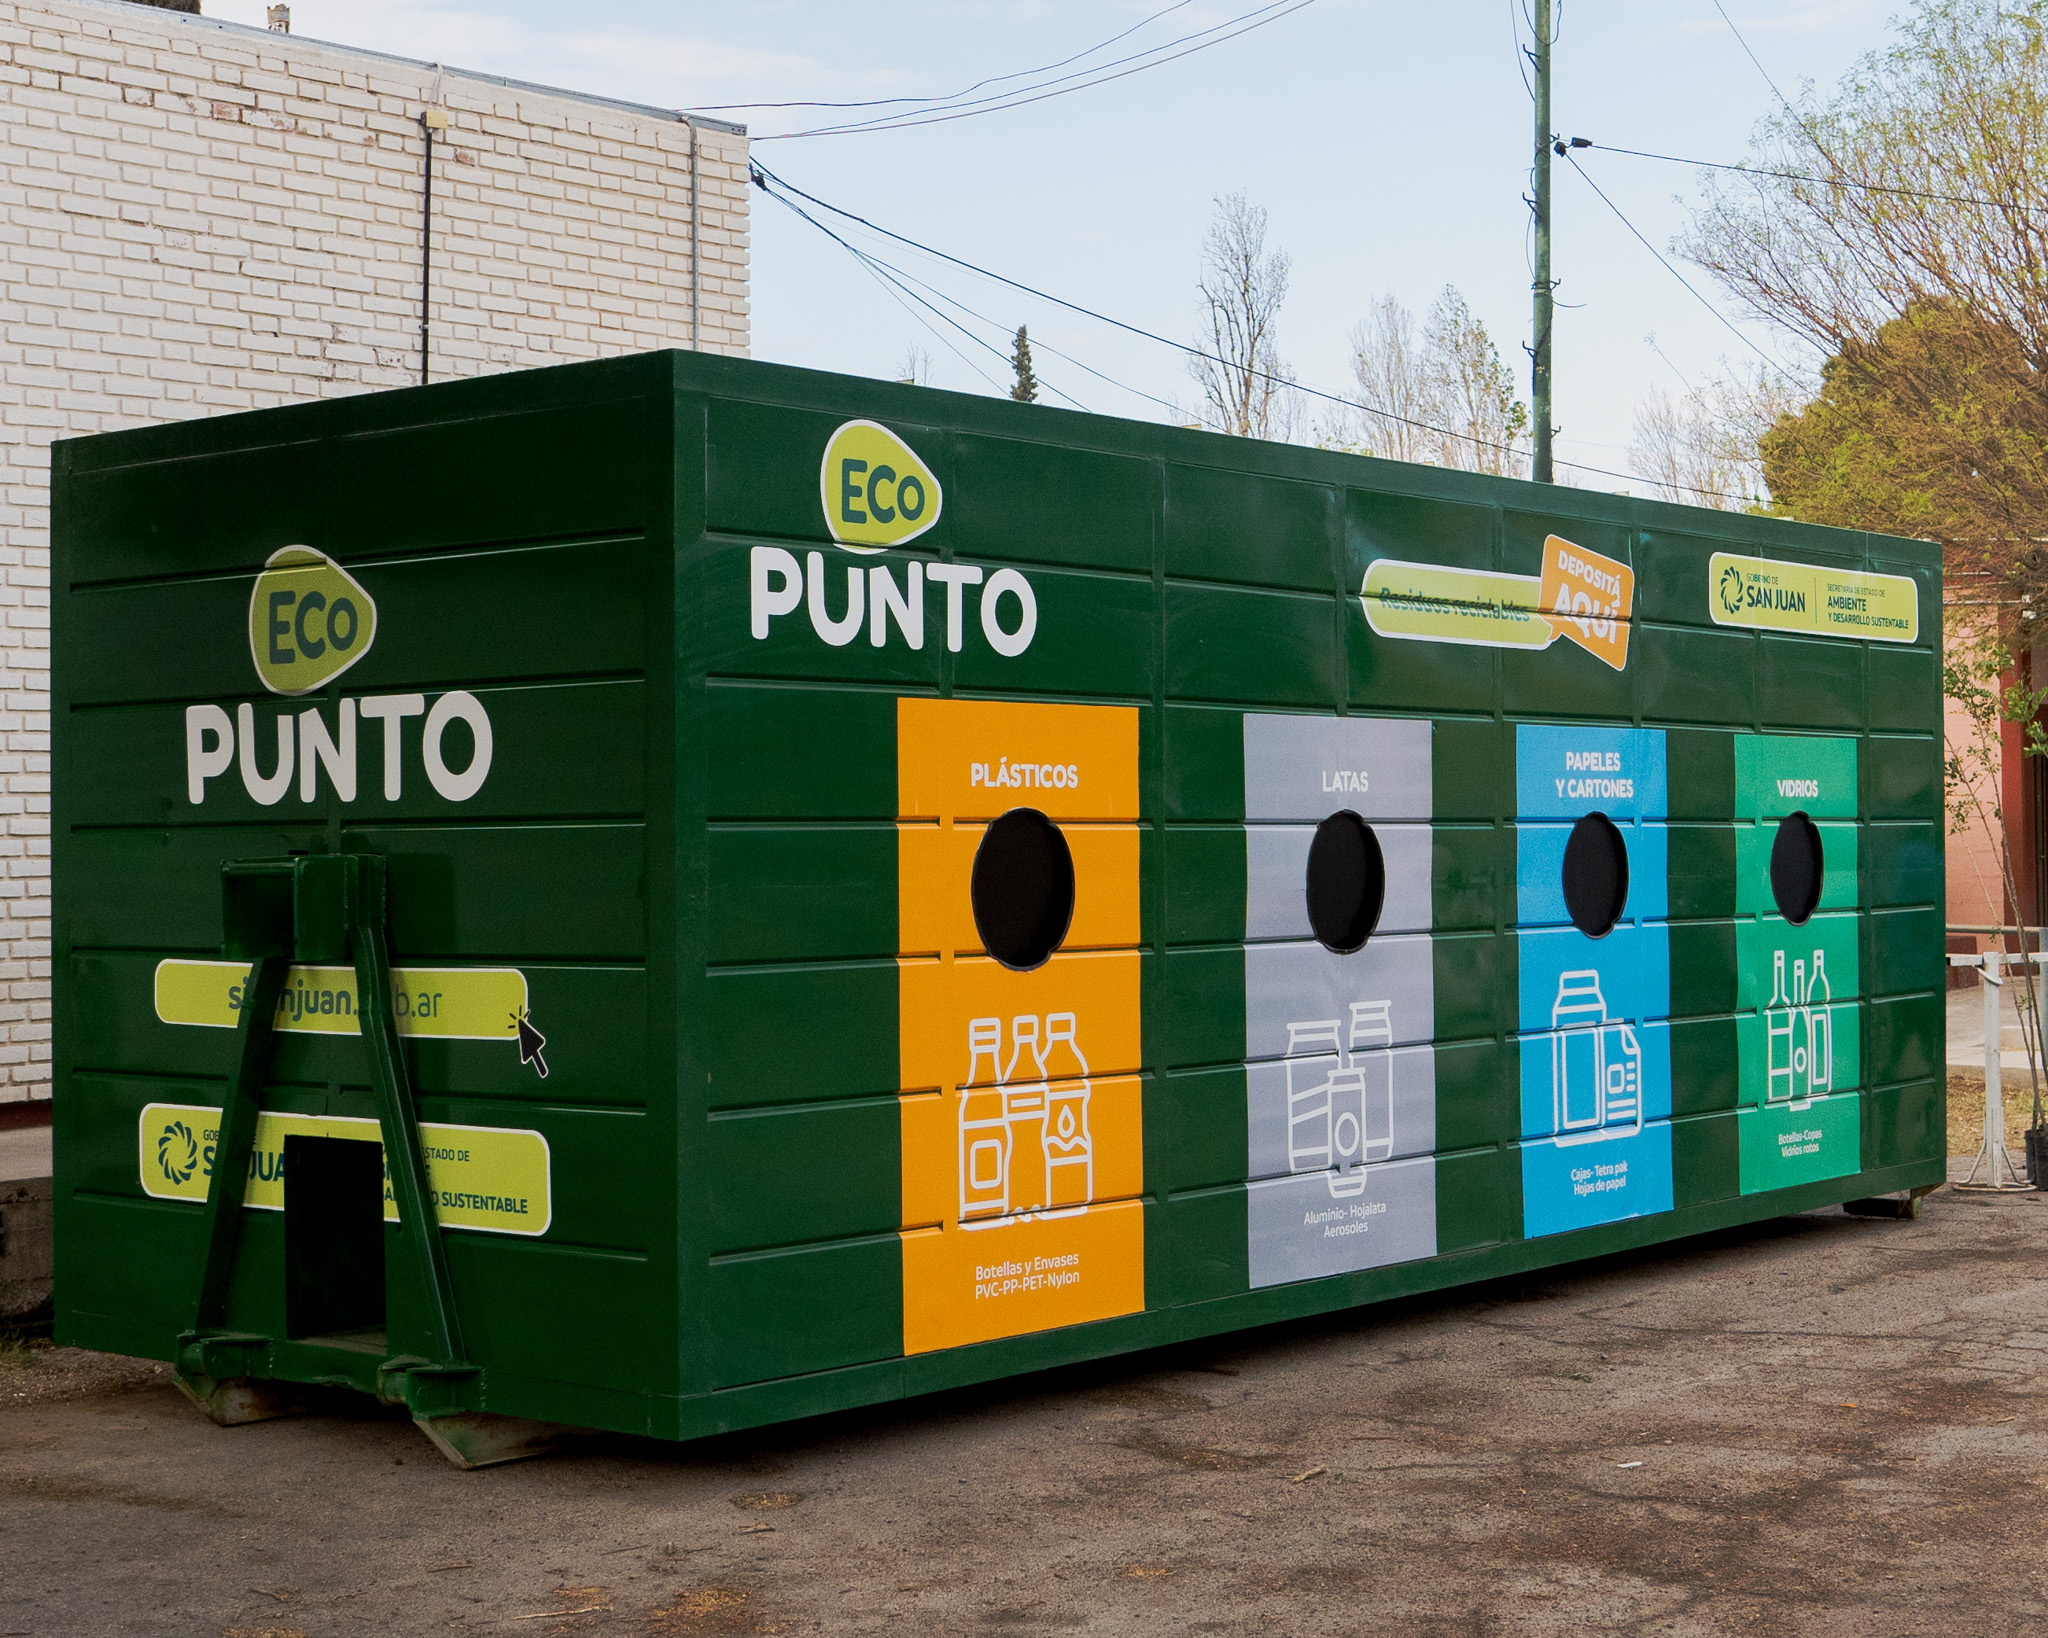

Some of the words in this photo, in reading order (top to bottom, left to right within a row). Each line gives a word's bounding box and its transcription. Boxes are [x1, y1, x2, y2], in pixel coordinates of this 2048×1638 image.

[841, 458, 925, 524] ECO
[1558, 550, 1621, 597] DEPOSITÁ
[750, 546, 1037, 657] PUNTO
[1746, 585, 1772, 609] SAN
[1775, 589, 1805, 613] JUAN
[1827, 596, 1866, 611] AMBIENTE
[1554, 582, 1620, 644] AQUÍ
[1828, 612, 1832, 621] Y
[1833, 613, 1870, 625] DESARROLLO
[1871, 616, 1909, 629] SUSTENTABLE
[269, 590, 358, 665] ECO
[186, 690, 493, 805] PUNTO
[971, 756, 1078, 789] PLÁSTICOS
[1566, 751, 1621, 771] PAPELES
[1322, 770, 1369, 793] LATAS
[1555, 778, 1565, 798] Y
[1567, 778, 1634, 798] CARTONES
[1776, 779, 1819, 798] VIDRIOS
[228, 976, 443, 1022] snjuan.b.ar
[423, 1146, 455, 1161] STADO
[457, 1149, 470, 1162] DE
[1782, 1145, 1802, 1157] Vidrios
[1803, 1143, 1819, 1154] rotos
[249, 1151, 285, 1182] JUA
[1594, 1165, 1614, 1177] Tetra
[1615, 1160, 1628, 1176] pak
[1574, 1182, 1594, 1197] Hojas
[1595, 1179, 1605, 1192] de
[1606, 1175, 1626, 1192] papel
[441, 1191, 528, 1215] SUSTENTABLE
[1304, 1207, 1347, 1225] Aluminio-
[1350, 1202, 1386, 1219] Hojalata
[1324, 1221, 1368, 1238] Aerosoles
[976, 1261, 1022, 1281] Botellas
[1024, 1261, 1032, 1276] y
[1034, 1253, 1079, 1271] Envases
[975, 1270, 1080, 1300] PVC-PP-PET-Nylon
